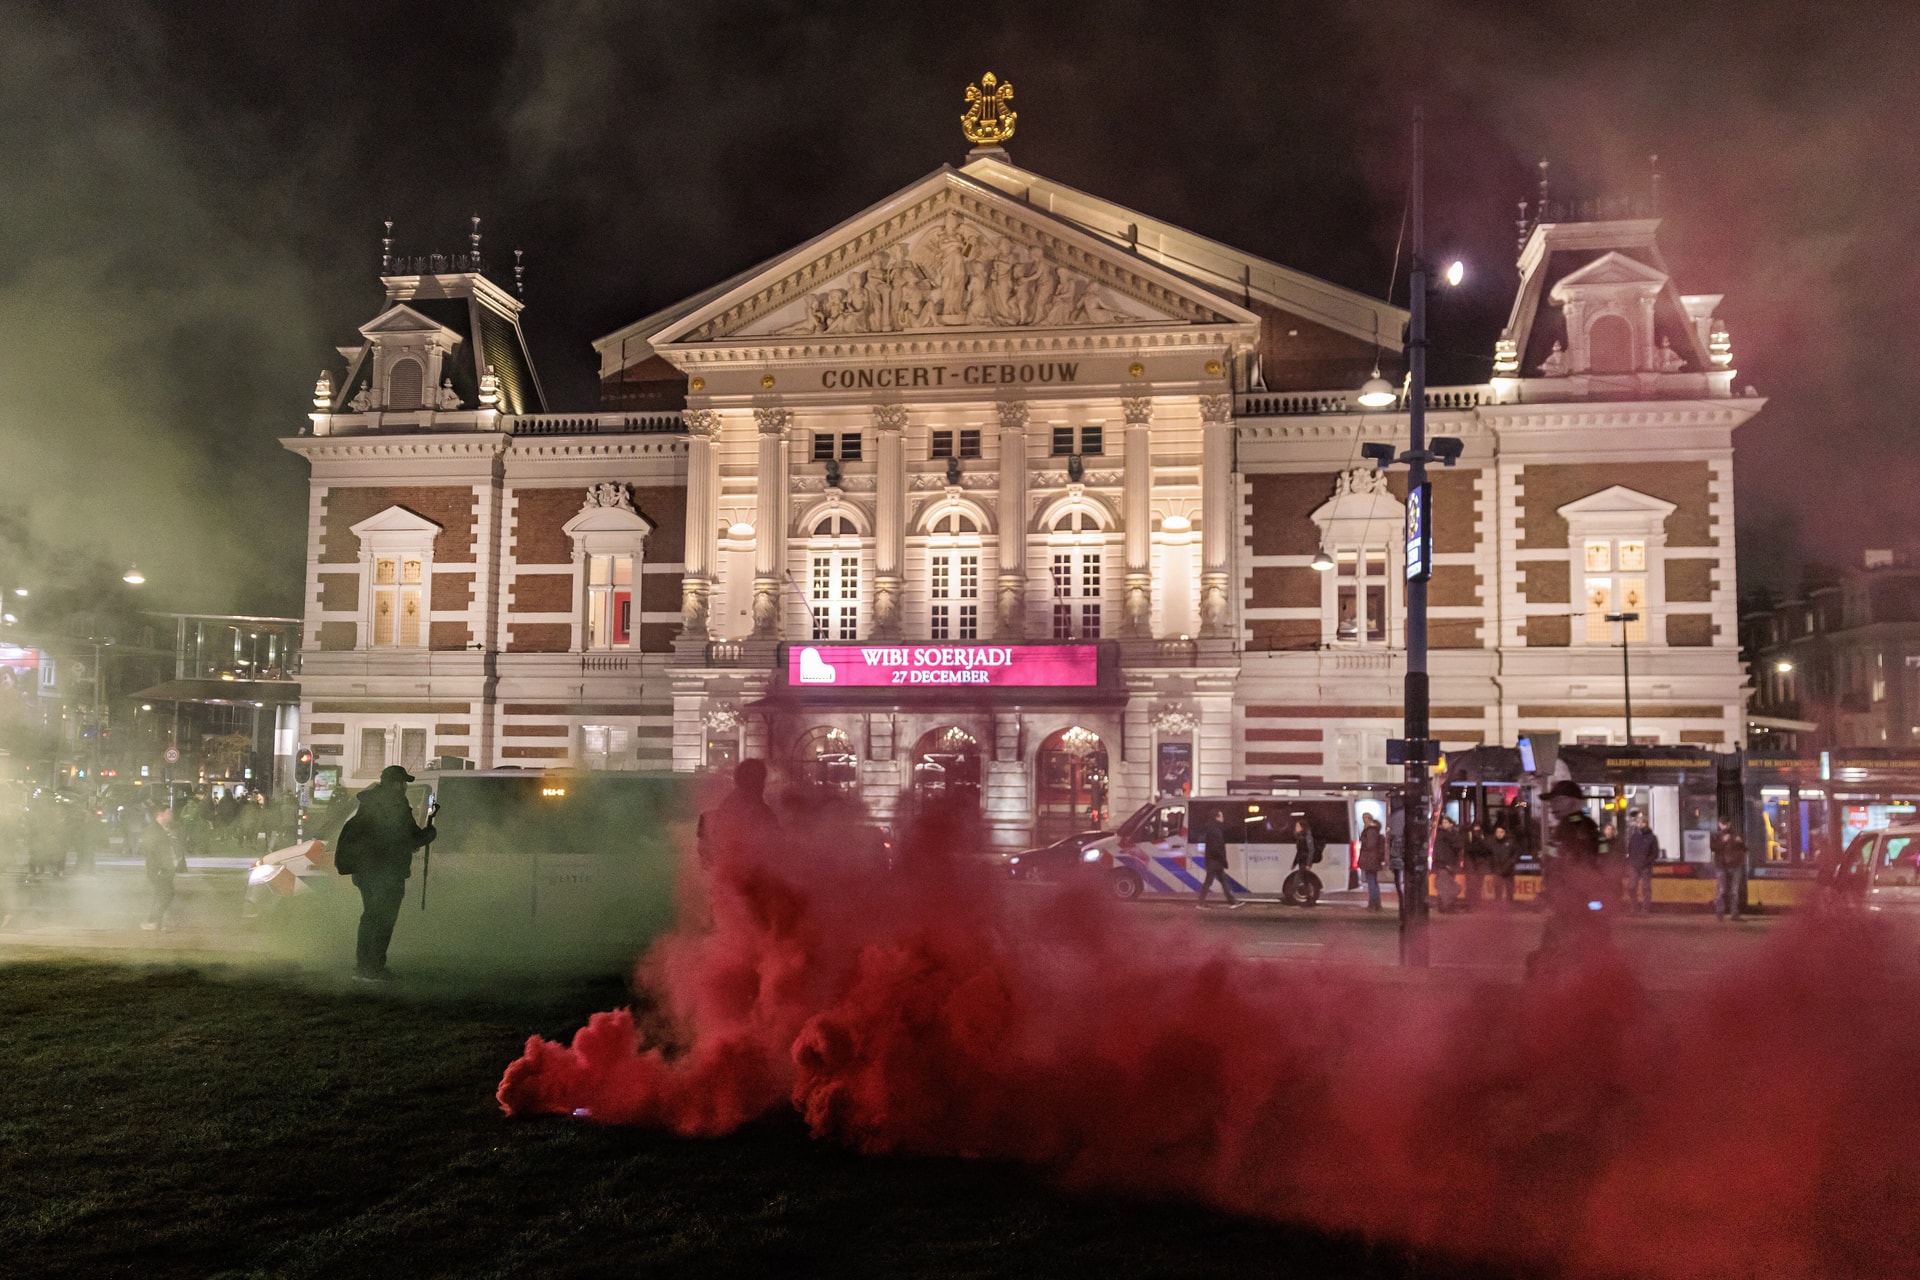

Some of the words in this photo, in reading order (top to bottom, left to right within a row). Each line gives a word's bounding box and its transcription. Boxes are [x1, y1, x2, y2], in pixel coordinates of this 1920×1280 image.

[822, 362, 1080, 388] CONCERT-GEBOUW
[861, 648, 909, 666] WIBI
[914, 648, 1013, 669] SOERJADI
[892, 670, 909, 684] 27
[910, 670, 990, 684] DECEMBER
